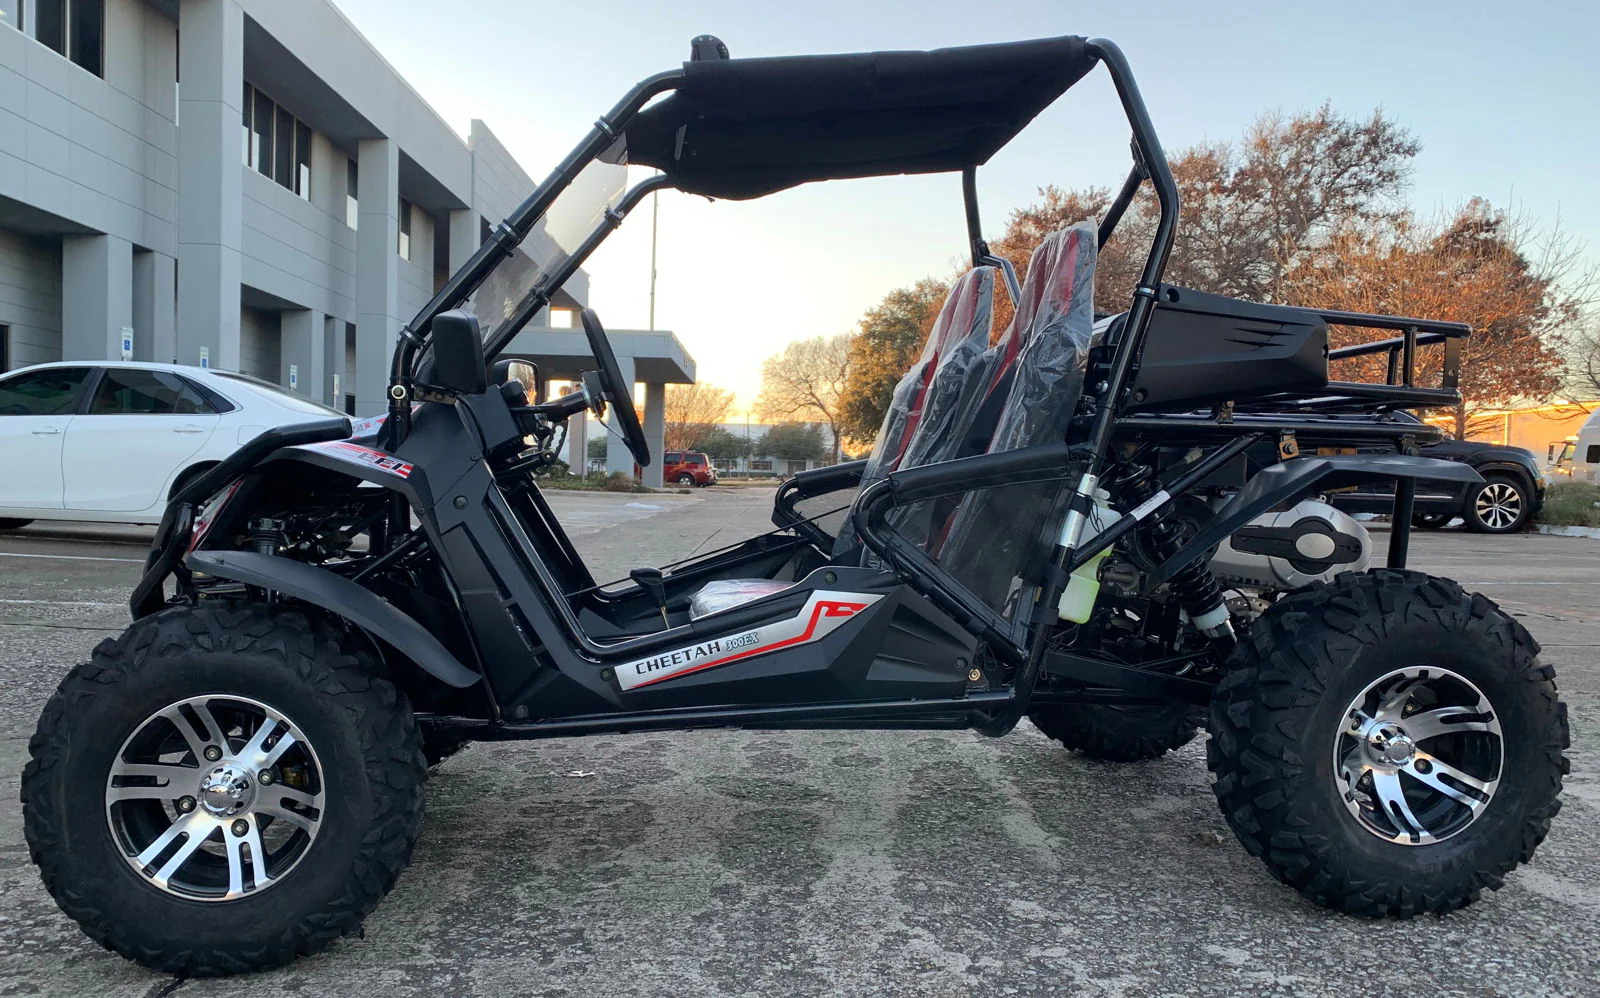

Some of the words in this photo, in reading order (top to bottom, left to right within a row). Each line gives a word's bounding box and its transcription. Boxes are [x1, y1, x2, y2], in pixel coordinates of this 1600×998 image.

[357, 452, 403, 470] EFI
[635, 641, 721, 675] CHEETAH
[726, 631, 760, 651] 300EX
